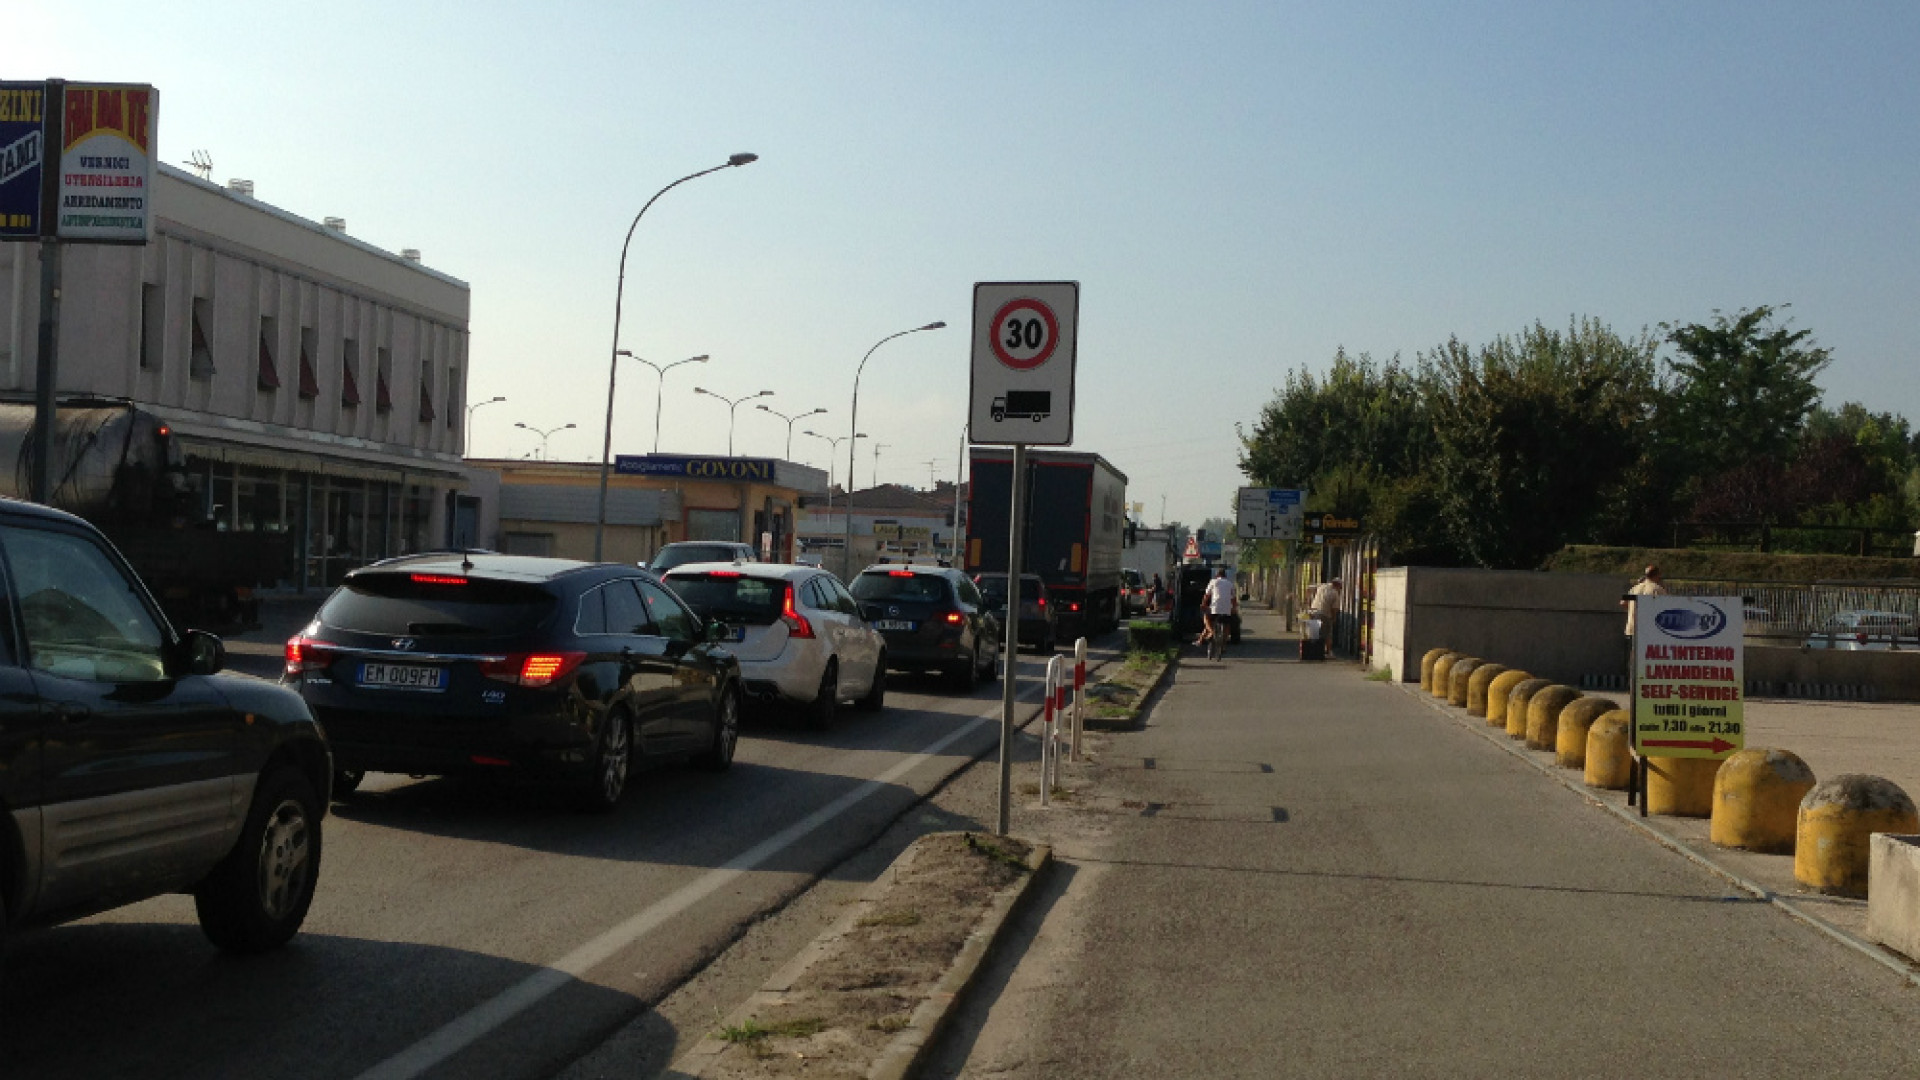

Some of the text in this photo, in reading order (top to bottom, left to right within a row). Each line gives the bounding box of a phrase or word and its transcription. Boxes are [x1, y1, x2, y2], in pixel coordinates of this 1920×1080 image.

[80, 156, 130, 170] VERNICI
[64, 174, 143, 187] UTENSILERIA
[62, 195, 143, 210] ARREDAMENTO
[1005, 318, 1043, 349] 30
[686, 459, 769, 479] GOVONI
[1645, 644, 1735, 662] ALL'INTERNO
[1645, 664, 1735, 682] LAVANDERIA
[1641, 684, 1740, 701] SELF-SERVICE
[1653, 703, 1681, 716] tutti
[1689, 704, 1727, 718] giorni
